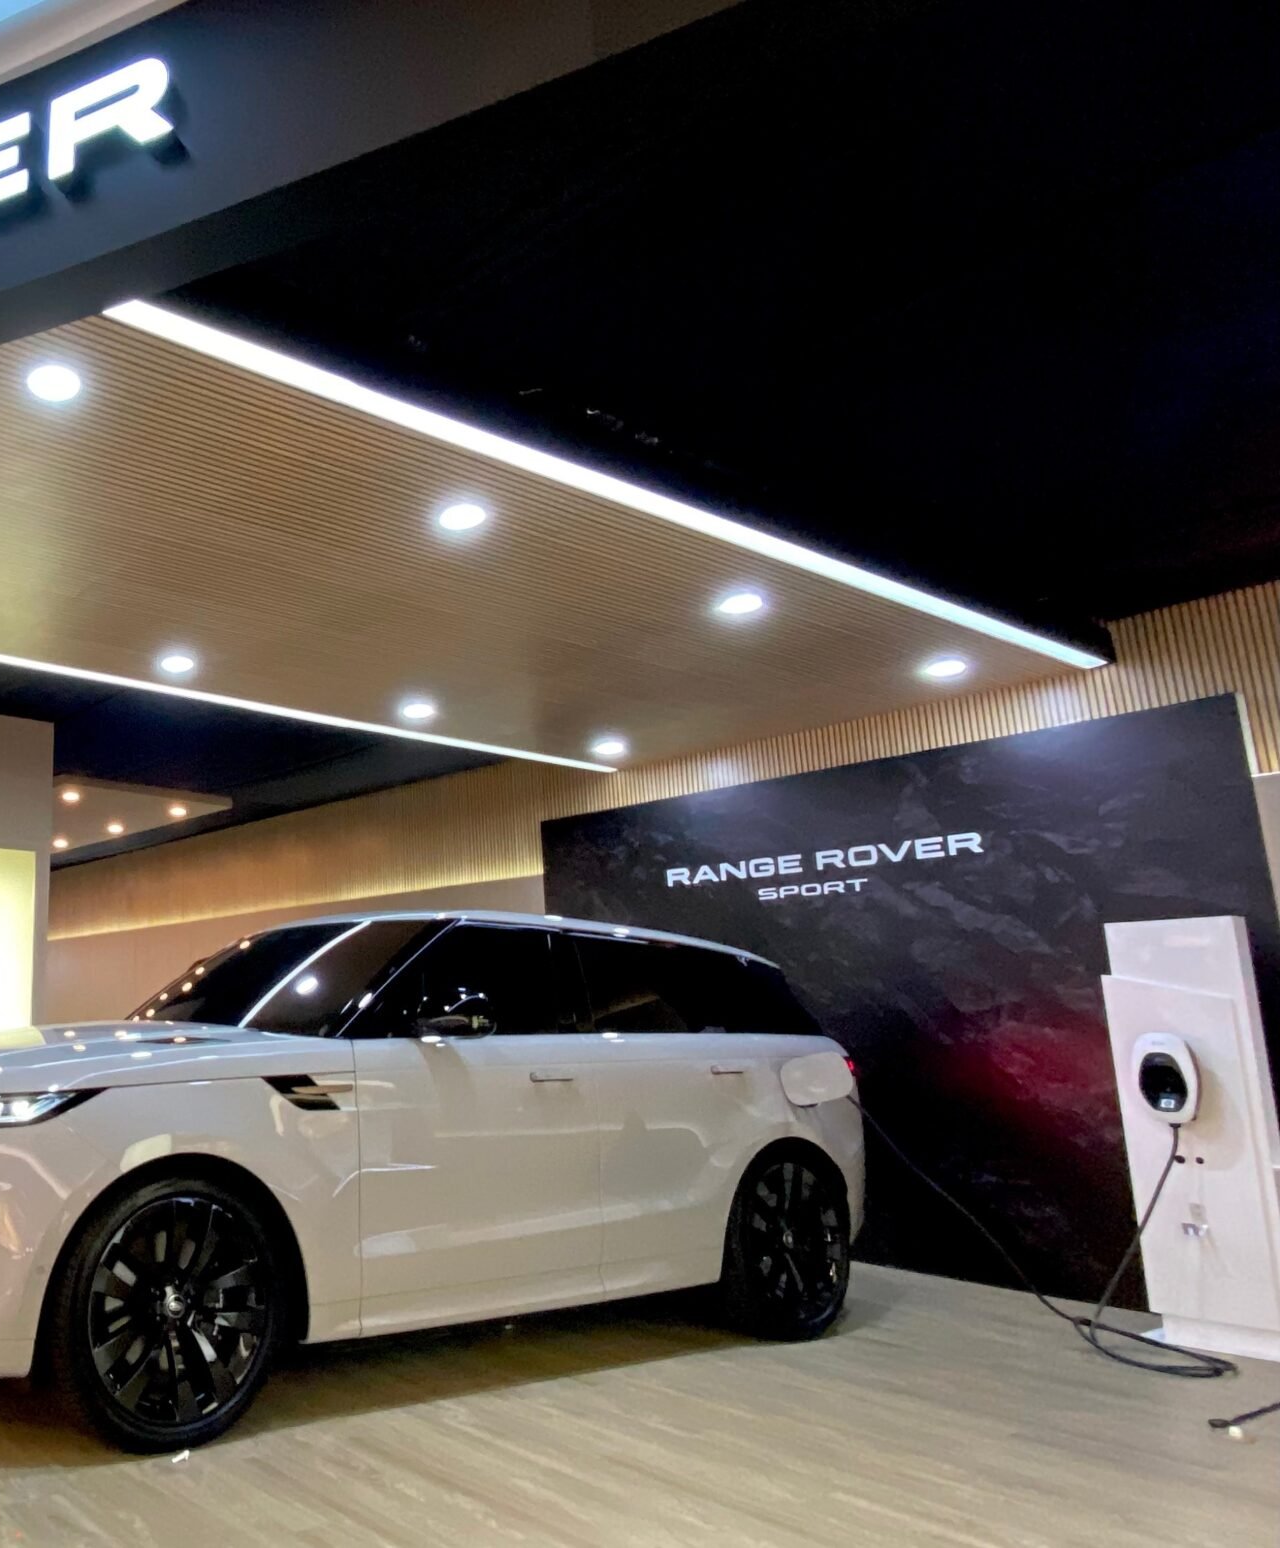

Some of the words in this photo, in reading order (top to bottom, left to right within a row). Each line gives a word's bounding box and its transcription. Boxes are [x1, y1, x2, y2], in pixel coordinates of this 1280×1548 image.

[666, 853, 803, 887] RANGE
[815, 832, 984, 871] ROVER
[757, 878, 869, 901] SPORT
